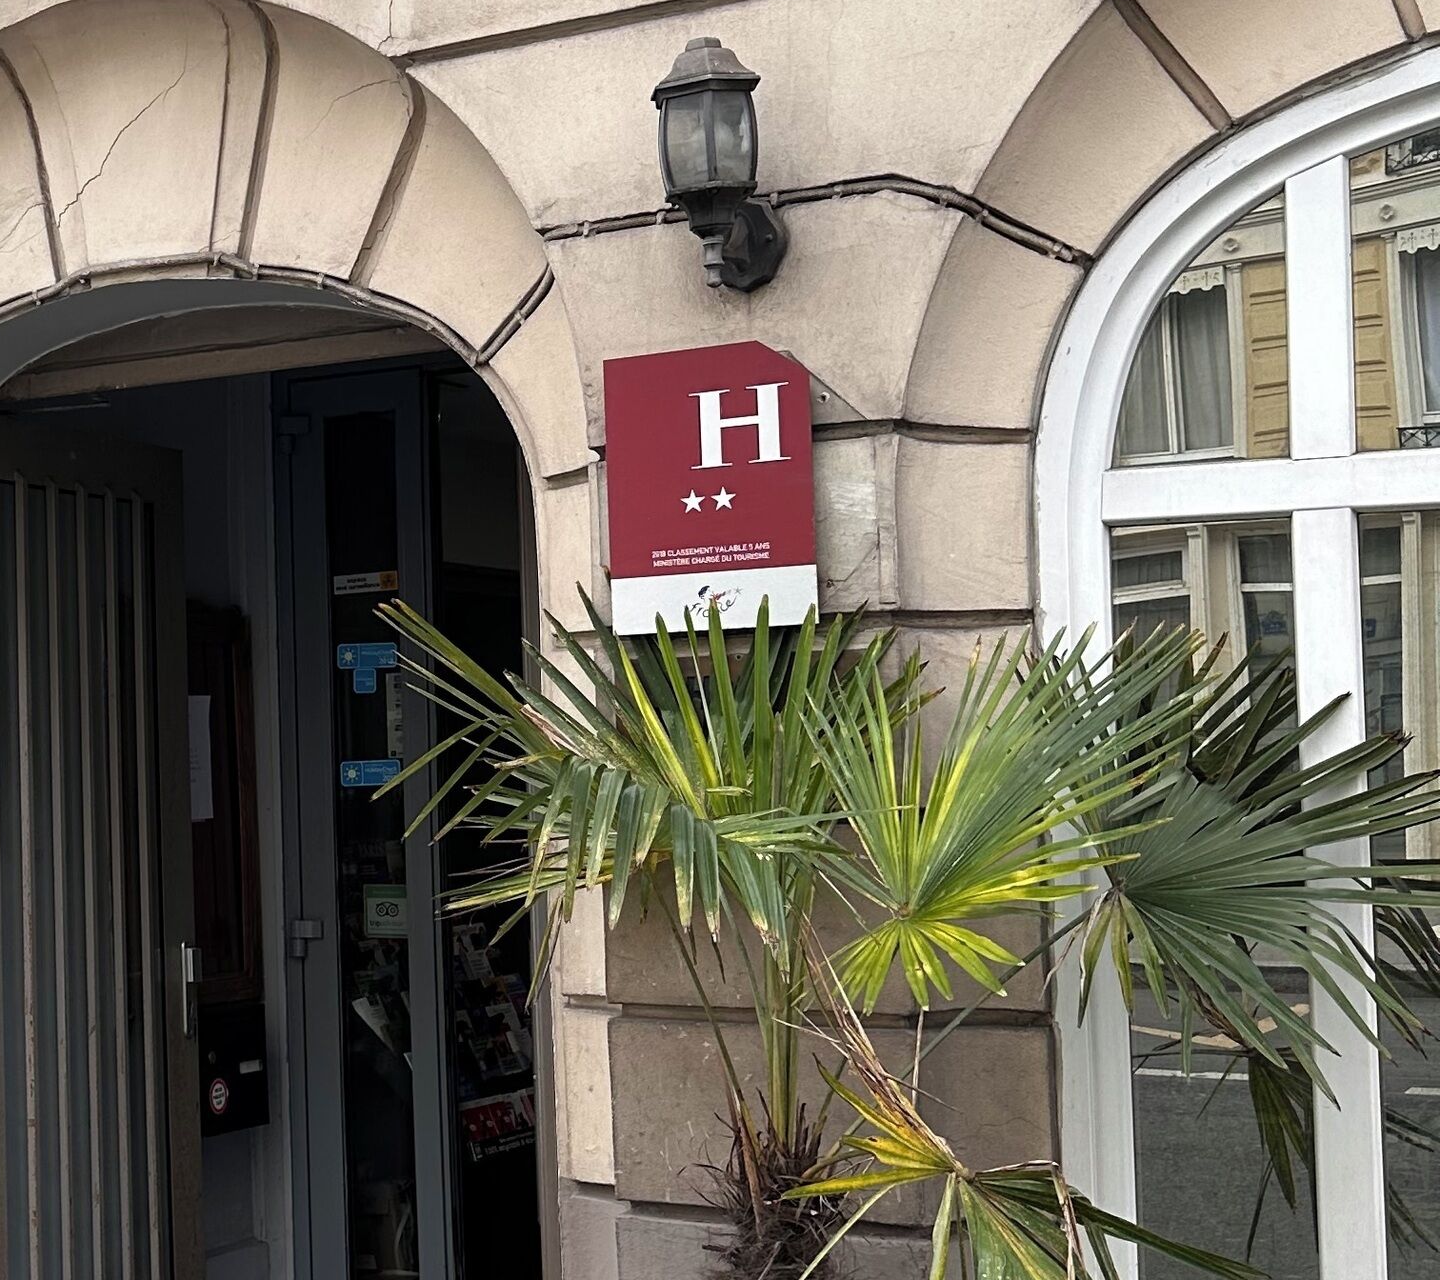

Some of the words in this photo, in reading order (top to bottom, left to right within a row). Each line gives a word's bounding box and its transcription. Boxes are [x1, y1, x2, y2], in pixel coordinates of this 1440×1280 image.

[688, 382, 792, 470] H
[667, 546, 713, 557] CLASSEMENT
[715, 543, 747, 553] VALABLE
[754, 542, 770, 550] ANS
[653, 557, 690, 568] MINISTÈRE
[691, 555, 720, 565] CHARGÉ
[721, 554, 732, 563] DU
[733, 551, 770, 561] TOURISME
